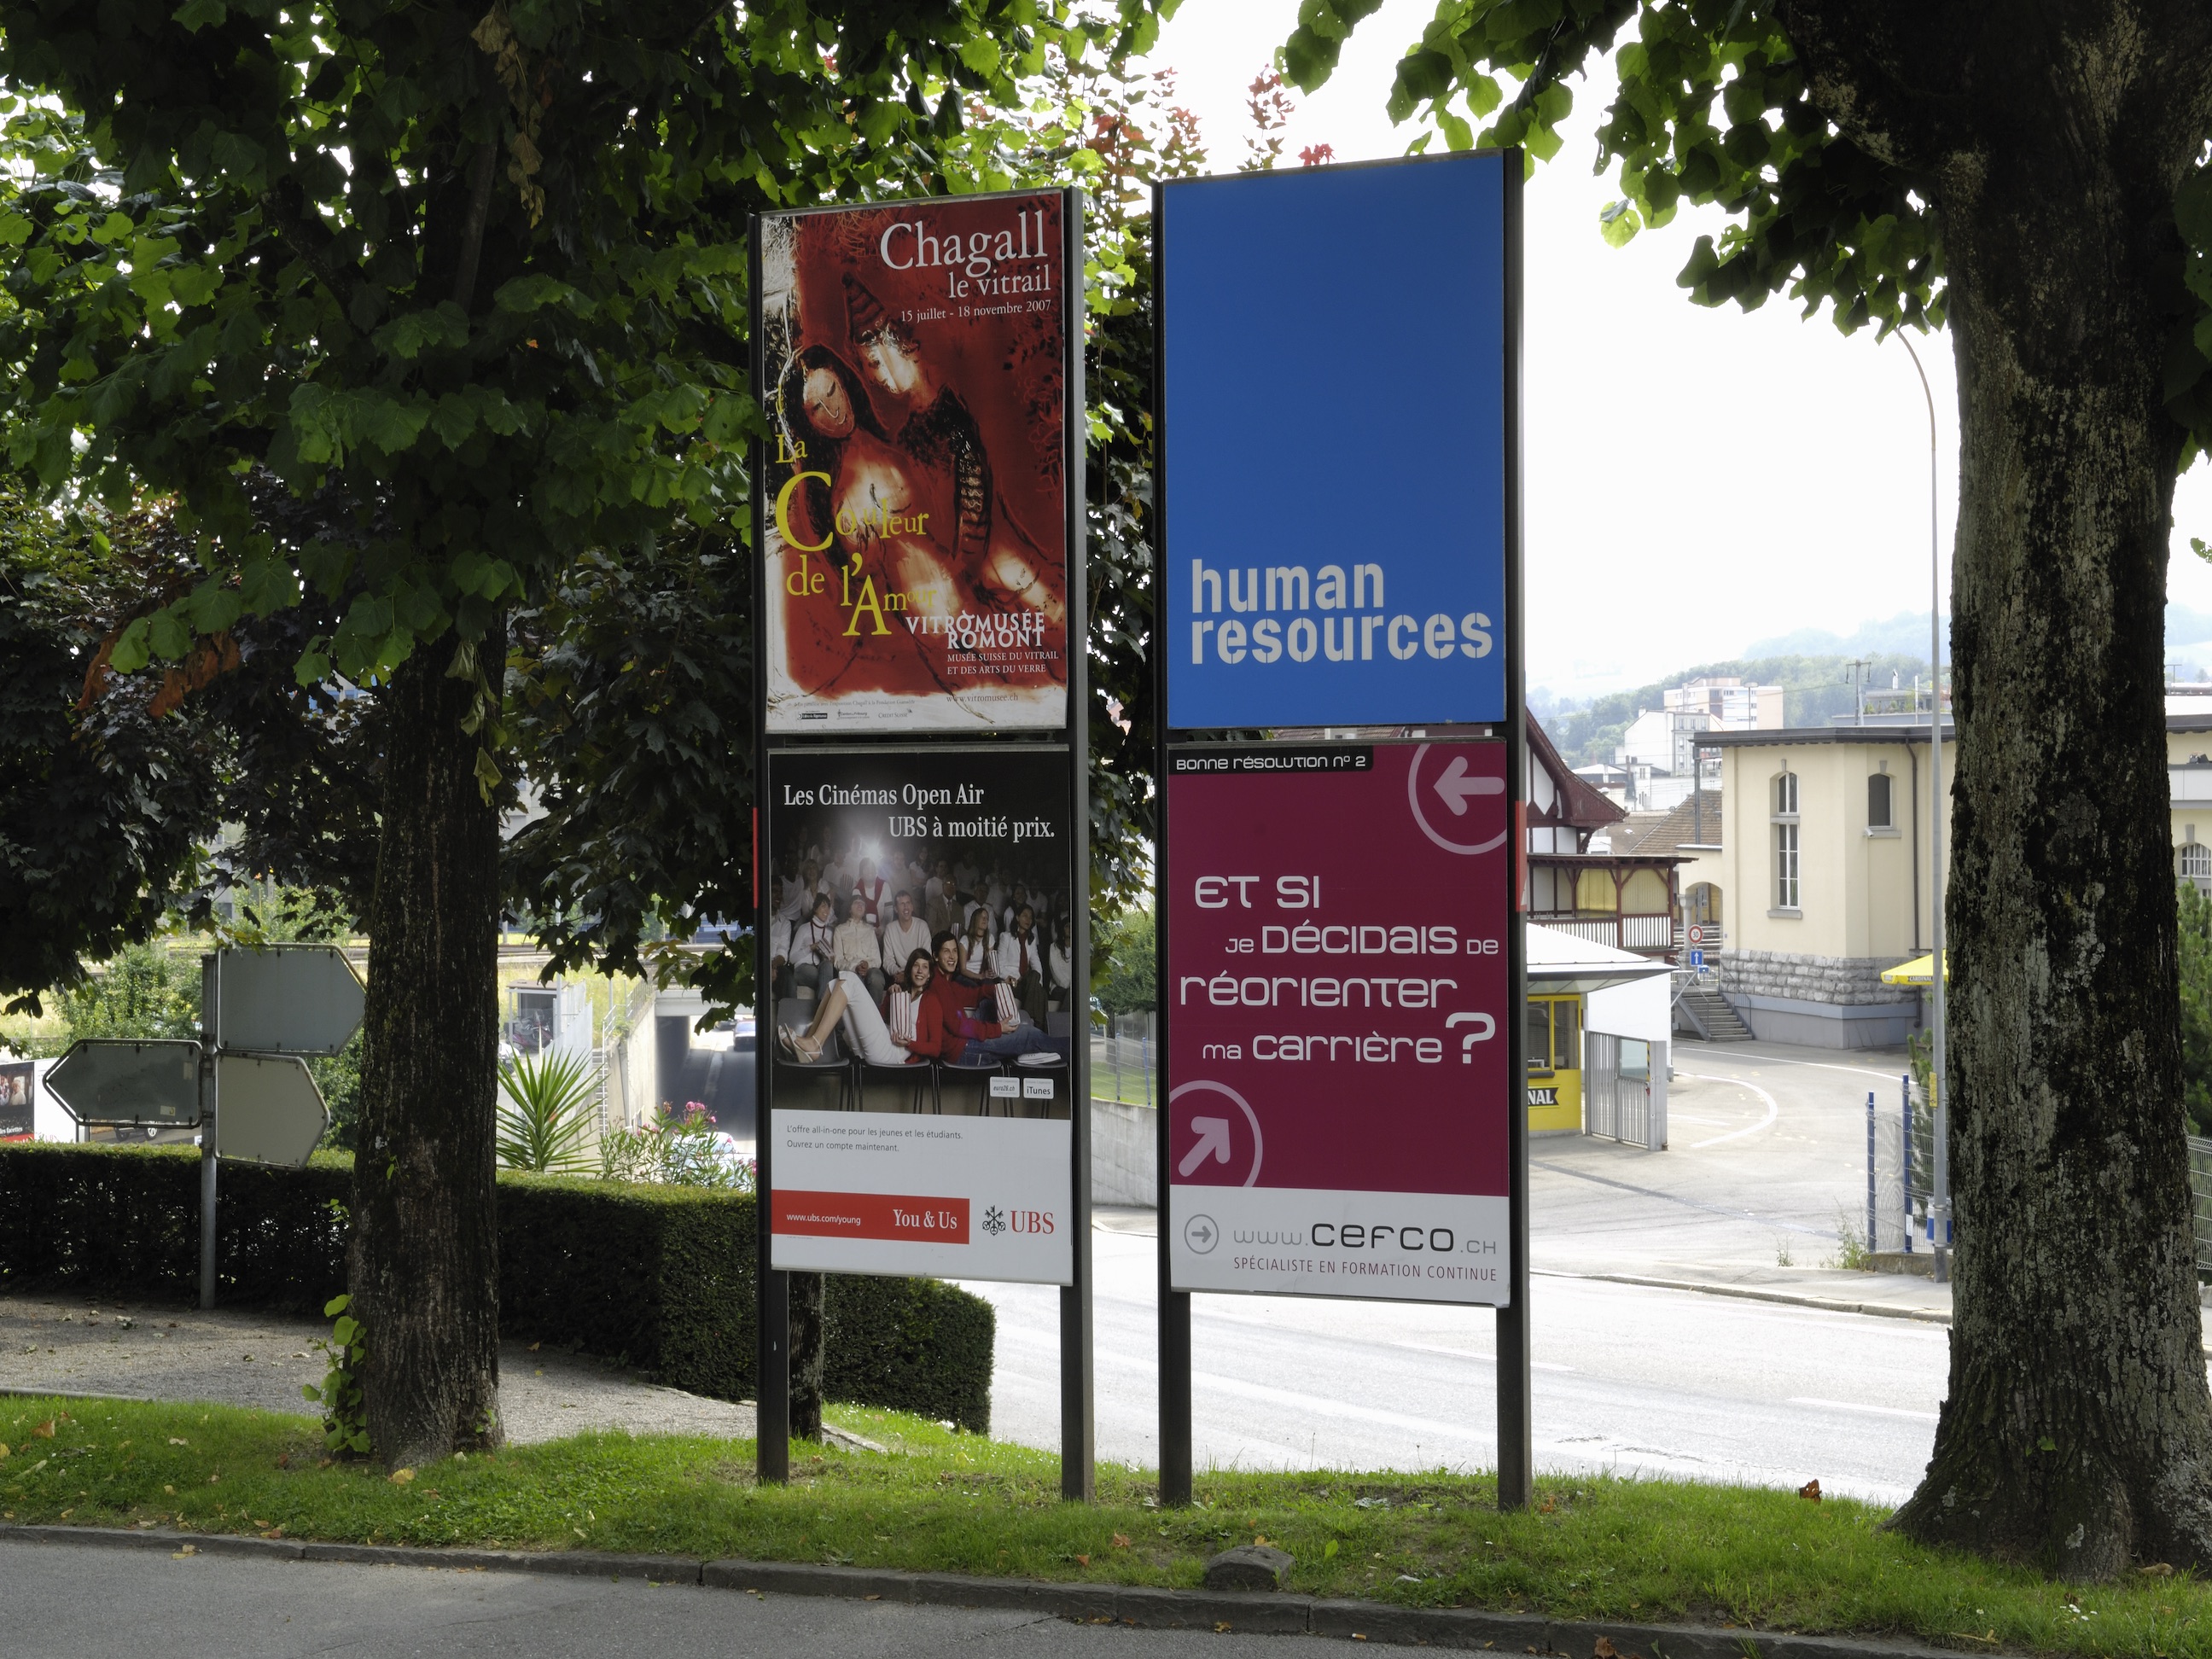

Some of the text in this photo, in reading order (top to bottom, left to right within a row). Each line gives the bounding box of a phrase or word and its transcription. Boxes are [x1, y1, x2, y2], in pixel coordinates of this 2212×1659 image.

[880, 210, 1049, 277] Chagall
[948, 265, 1051, 299] le vitrail
[901, 310, 913, 322] 15
[916, 307, 946, 323] juillet
[958, 306, 970, 317] 18
[974, 302, 1023, 317] novembre
[1026, 299, 1051, 312] 2007
[775, 434, 808, 463] La
[775, 470, 929, 552] Couleur
[786, 555, 825, 596] de
[1191, 558, 1384, 613] human
[947, 630, 1045, 649] ROMONT
[1191, 612, 1493, 664] resources
[947, 651, 1059, 662] MUSÉE SUISSE DU VITRAIL
[947, 664, 1046, 675] ET DES ARTS DU VERRE
[946, 693, 1018, 702] www.vitromusee.ch
[1355, 755, 1366, 767] 2
[783, 783, 984, 810] Les Cinémas Open Air
[888, 816, 1056, 843] UBS à moitié prix.
[1195, 876, 1319, 908] ET SI
[1202, 1043, 1242, 1059] ma
[1027, 1086, 1051, 1095] iTunes
[787, 1124, 963, 1139] L'offre all-in-one pour les jeunes et les étudiants.
[787, 1139, 812, 1150] Ouvrez
[826, 1142, 853, 1153] compte
[855, 1141, 899, 1152] maintenant.
[786, 1213, 861, 1225] www.ubs.com/young
[893, 1208, 958, 1229] You & Us
[1010, 1210, 1055, 1234] UBS
[1234, 1254, 1497, 1282] SPÉCIALISTE EN FORMATION CONTINUE
